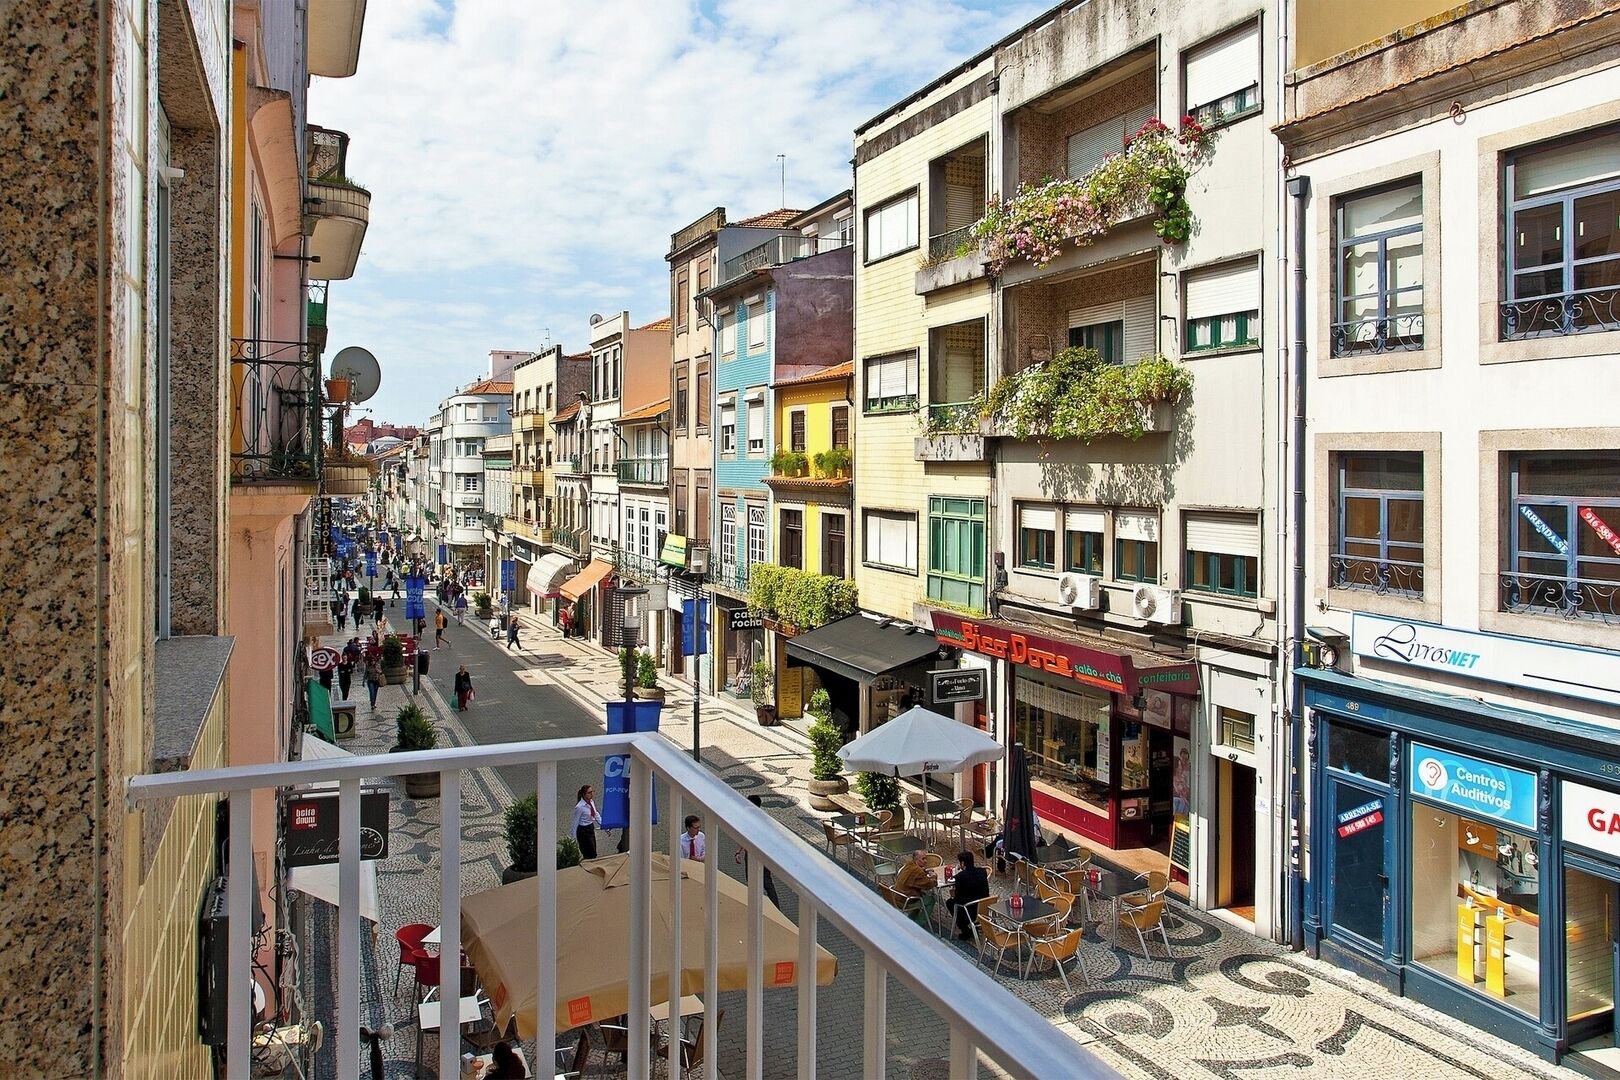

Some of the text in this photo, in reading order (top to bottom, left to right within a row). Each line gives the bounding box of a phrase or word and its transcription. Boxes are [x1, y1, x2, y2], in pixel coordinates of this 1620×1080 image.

[322, 499, 330, 558] APITOLIO
[1520, 506, 1568, 553] ARRENDA-SE
[1584, 512, 1600, 528] 916
[731, 617, 763, 628] rocha
[961, 621, 1008, 659] Bico
[1010, 633, 1073, 678] Doce
[1074, 664, 1098, 677] salão
[1105, 671, 1122, 684] chá
[1139, 669, 1191, 684] confeitaria
[1456, 767, 1506, 791] Centros
[1451, 783, 1511, 810] Auditivos
